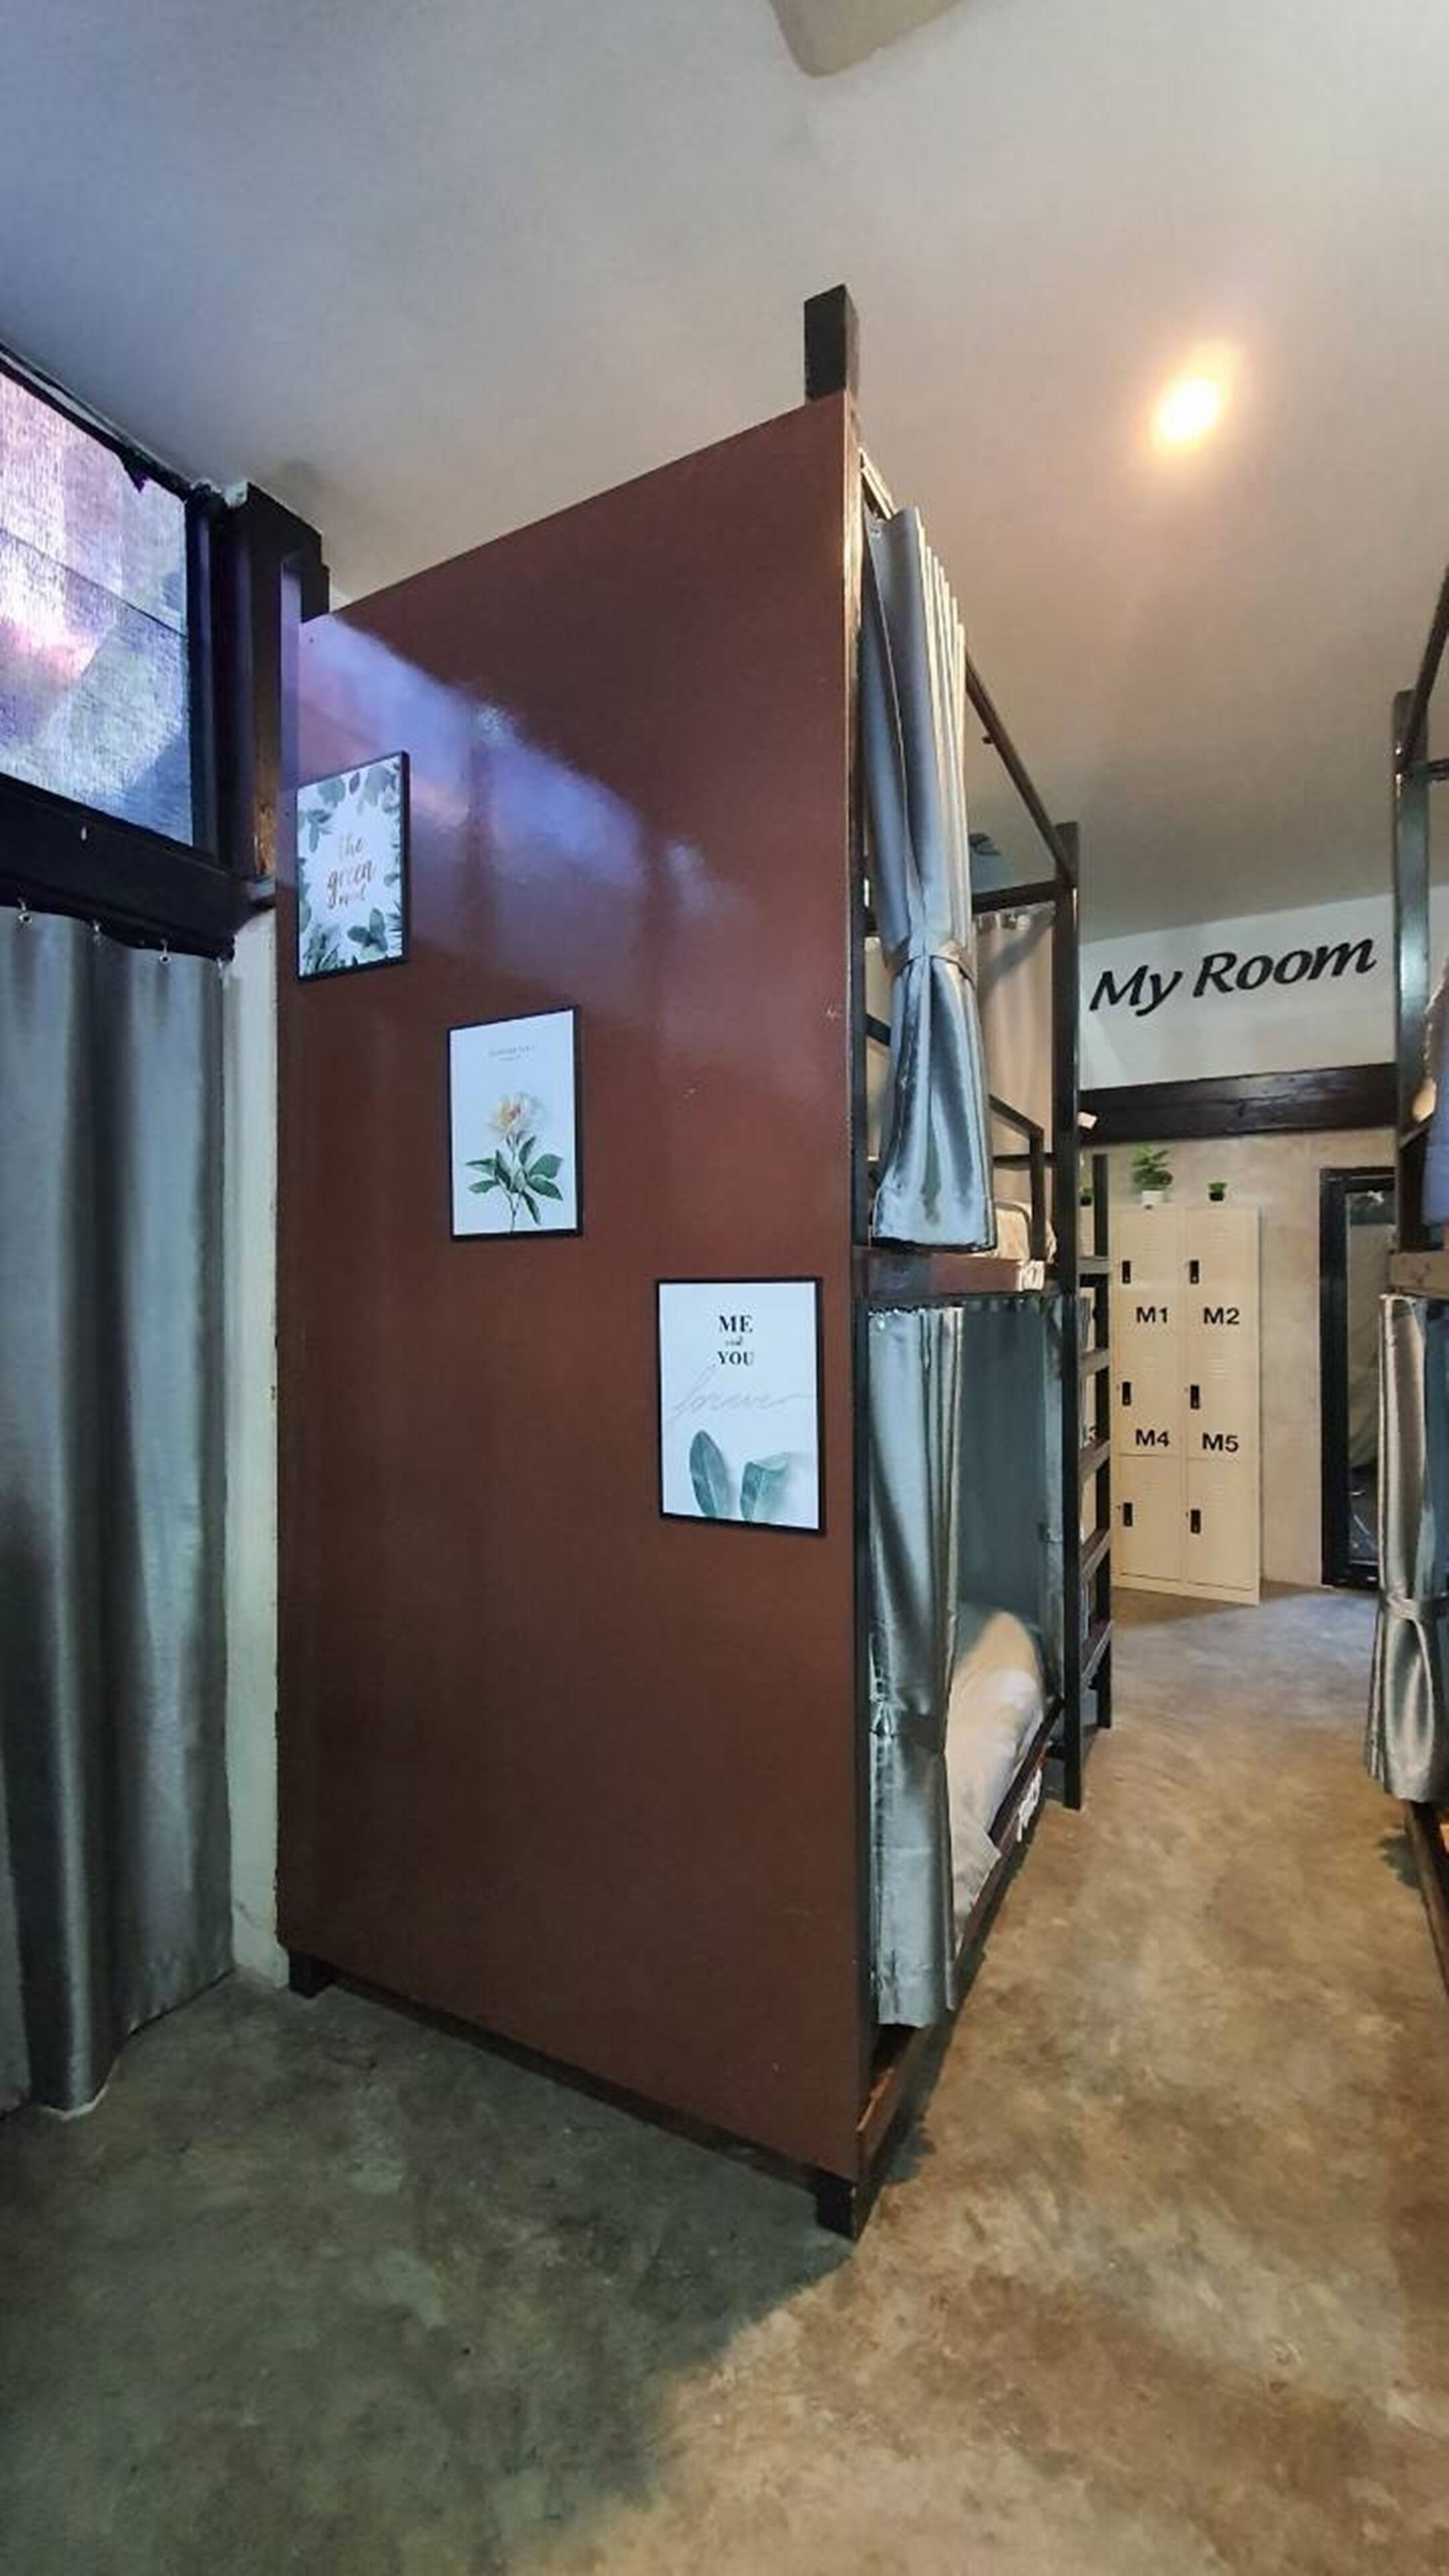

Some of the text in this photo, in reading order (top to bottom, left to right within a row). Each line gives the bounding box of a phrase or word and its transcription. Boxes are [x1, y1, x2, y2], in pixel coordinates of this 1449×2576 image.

[1089, 938, 1377, 1016] My Room
[718, 1314, 753, 1334] ME
[1135, 1305, 1169, 1324] M1
[1203, 1307, 1240, 1325] M2
[716, 1350, 755, 1366] YOU
[1135, 1429, 1170, 1448] M4
[1201, 1432, 1240, 1453] M5
